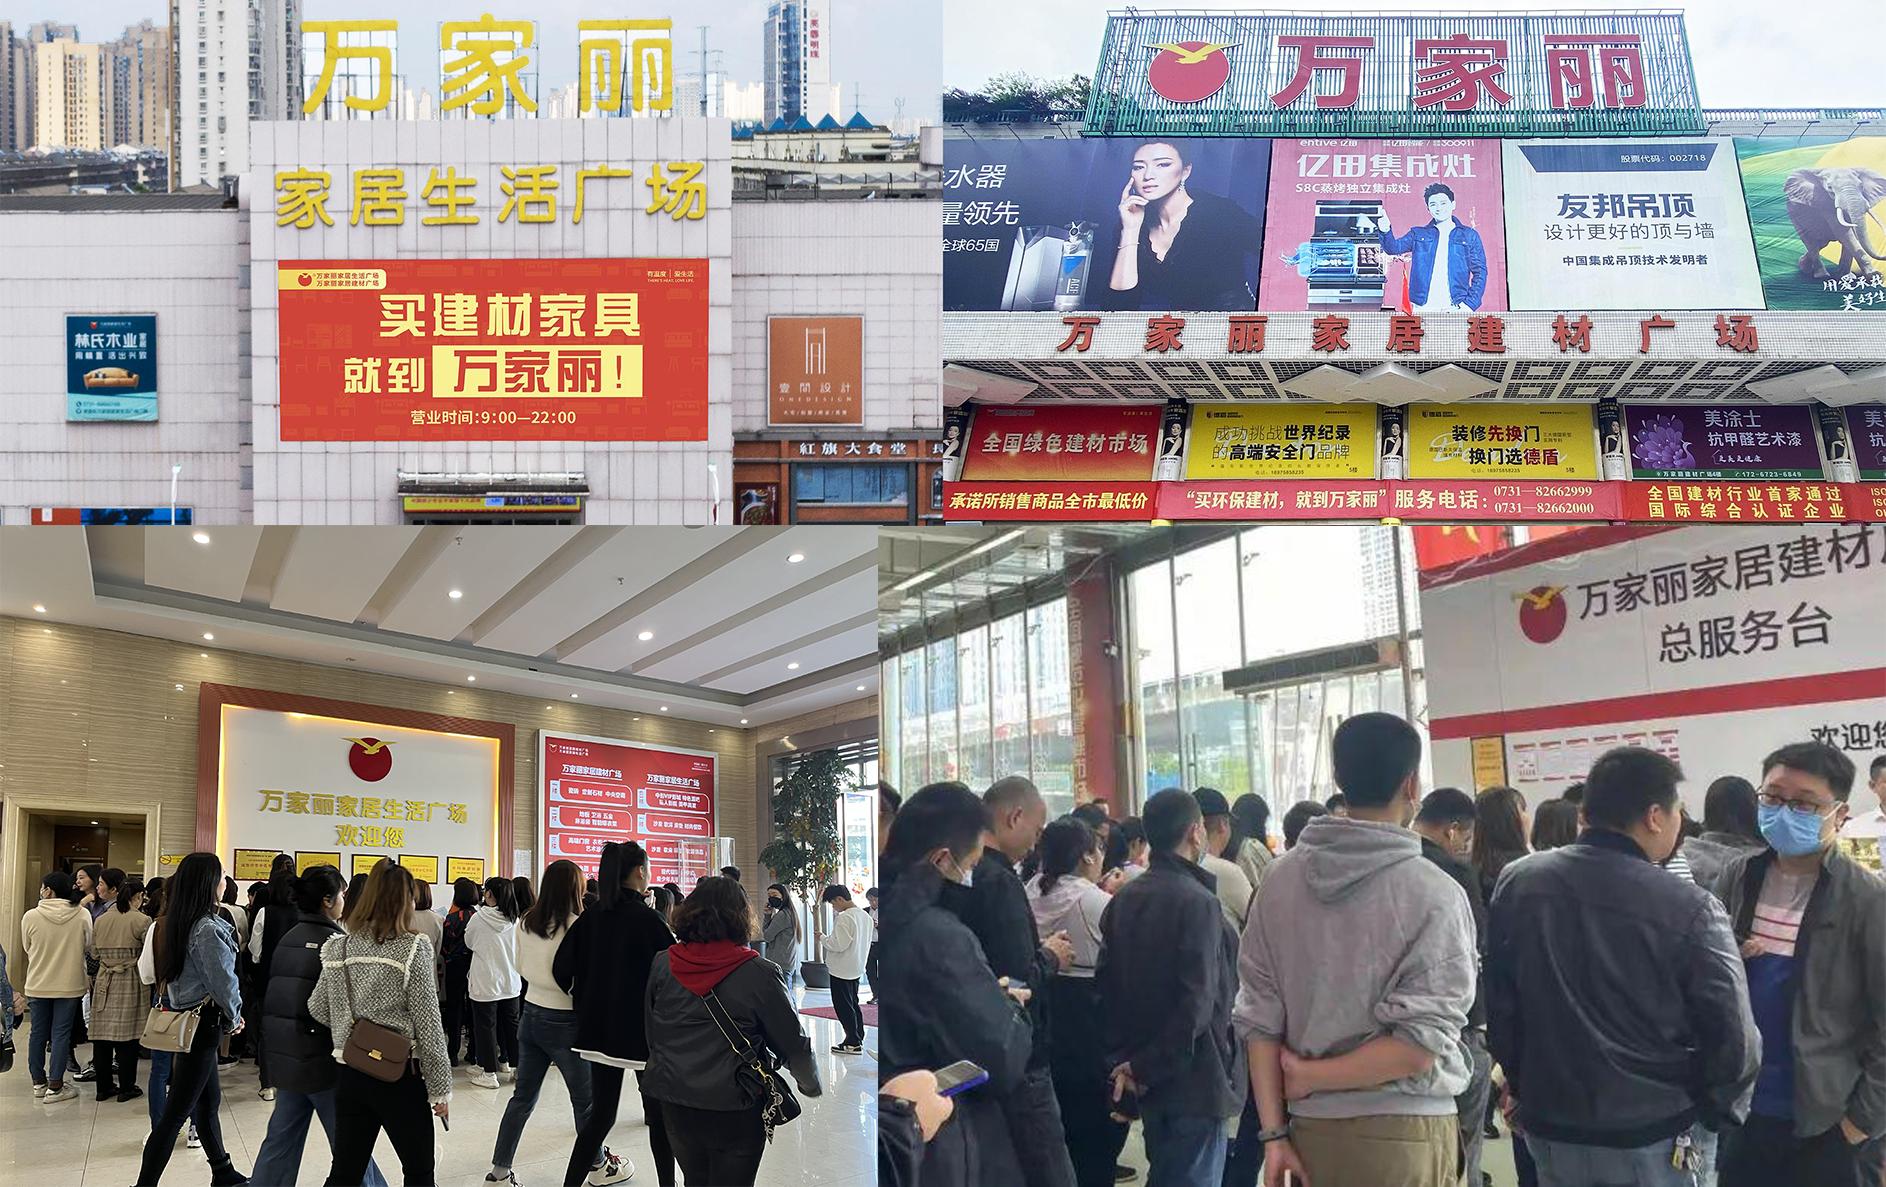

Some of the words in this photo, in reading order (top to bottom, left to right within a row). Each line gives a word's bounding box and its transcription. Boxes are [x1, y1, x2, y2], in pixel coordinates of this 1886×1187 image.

[303, 14, 673, 114] 万家丽
[1270, 33, 1646, 110] 万家丽
[1297, 154, 1477, 178] 亿田集成灶
[943, 164, 1007, 188] 水器
[274, 161, 706, 228] 家居生活广场
[1296, 183, 1411, 194] S8C蒸烤独立集成灶
[1557, 193, 1697, 219] 友邦吊顶
[1544, 222, 1715, 241] 设计更好的顶与墙
[1562, 254, 1708, 266] 中国集成吊顶技术发明者
[380, 293, 641, 338] 买建材家具
[74, 333, 138, 349] 林氏木业
[1057, 314, 1759, 353] 万家丽家居建材广场
[344, 357, 425, 393] 就到
[453, 349, 622, 393] 万家丽!
[410, 410, 576, 425] 营业时间:9:00—22:00
[1703, 409, 1762, 428] 美涂士
[1863, 410, 1886, 428] 美
[1213, 424, 1351, 441] 成功挑战世界纪录
[1452, 425, 1541, 442] 装修先换门
[1708, 431, 1802, 447] 抗甲醛艺术漆
[800, 442, 907, 455] 紅旗大食堂
[982, 431, 1148, 454] 全国绿色建材市场
[1212, 443, 1350, 461] 的高端安全门品牌
[1469, 448, 1559, 466] 换门选德盾
[1187, 489, 1386, 509] “买环保建材，就到万家丽”
[1395, 489, 1488, 509] 服务电话:
[1494, 486, 1592, 497] 0731—82662999
[1648, 485, 1842, 501] 全国建材行业首家通过
[949, 492, 1148, 510] 承诺所销售商品全市最低价
[1495, 502, 1594, 514] 0731—82662000
[1649, 503, 1846, 519] 国际综合认证企业
[1577, 525, 1886, 620] 万家丽家居建材
[1659, 601, 1834, 663] 总服务台
[562, 764, 622, 778] 万家丽家居建材广场
[647, 774, 700, 786] 万家丽家居生活广场
[257, 789, 468, 824] 万家丽家居生活广场
[335, 824, 405, 848] 欢迎您
